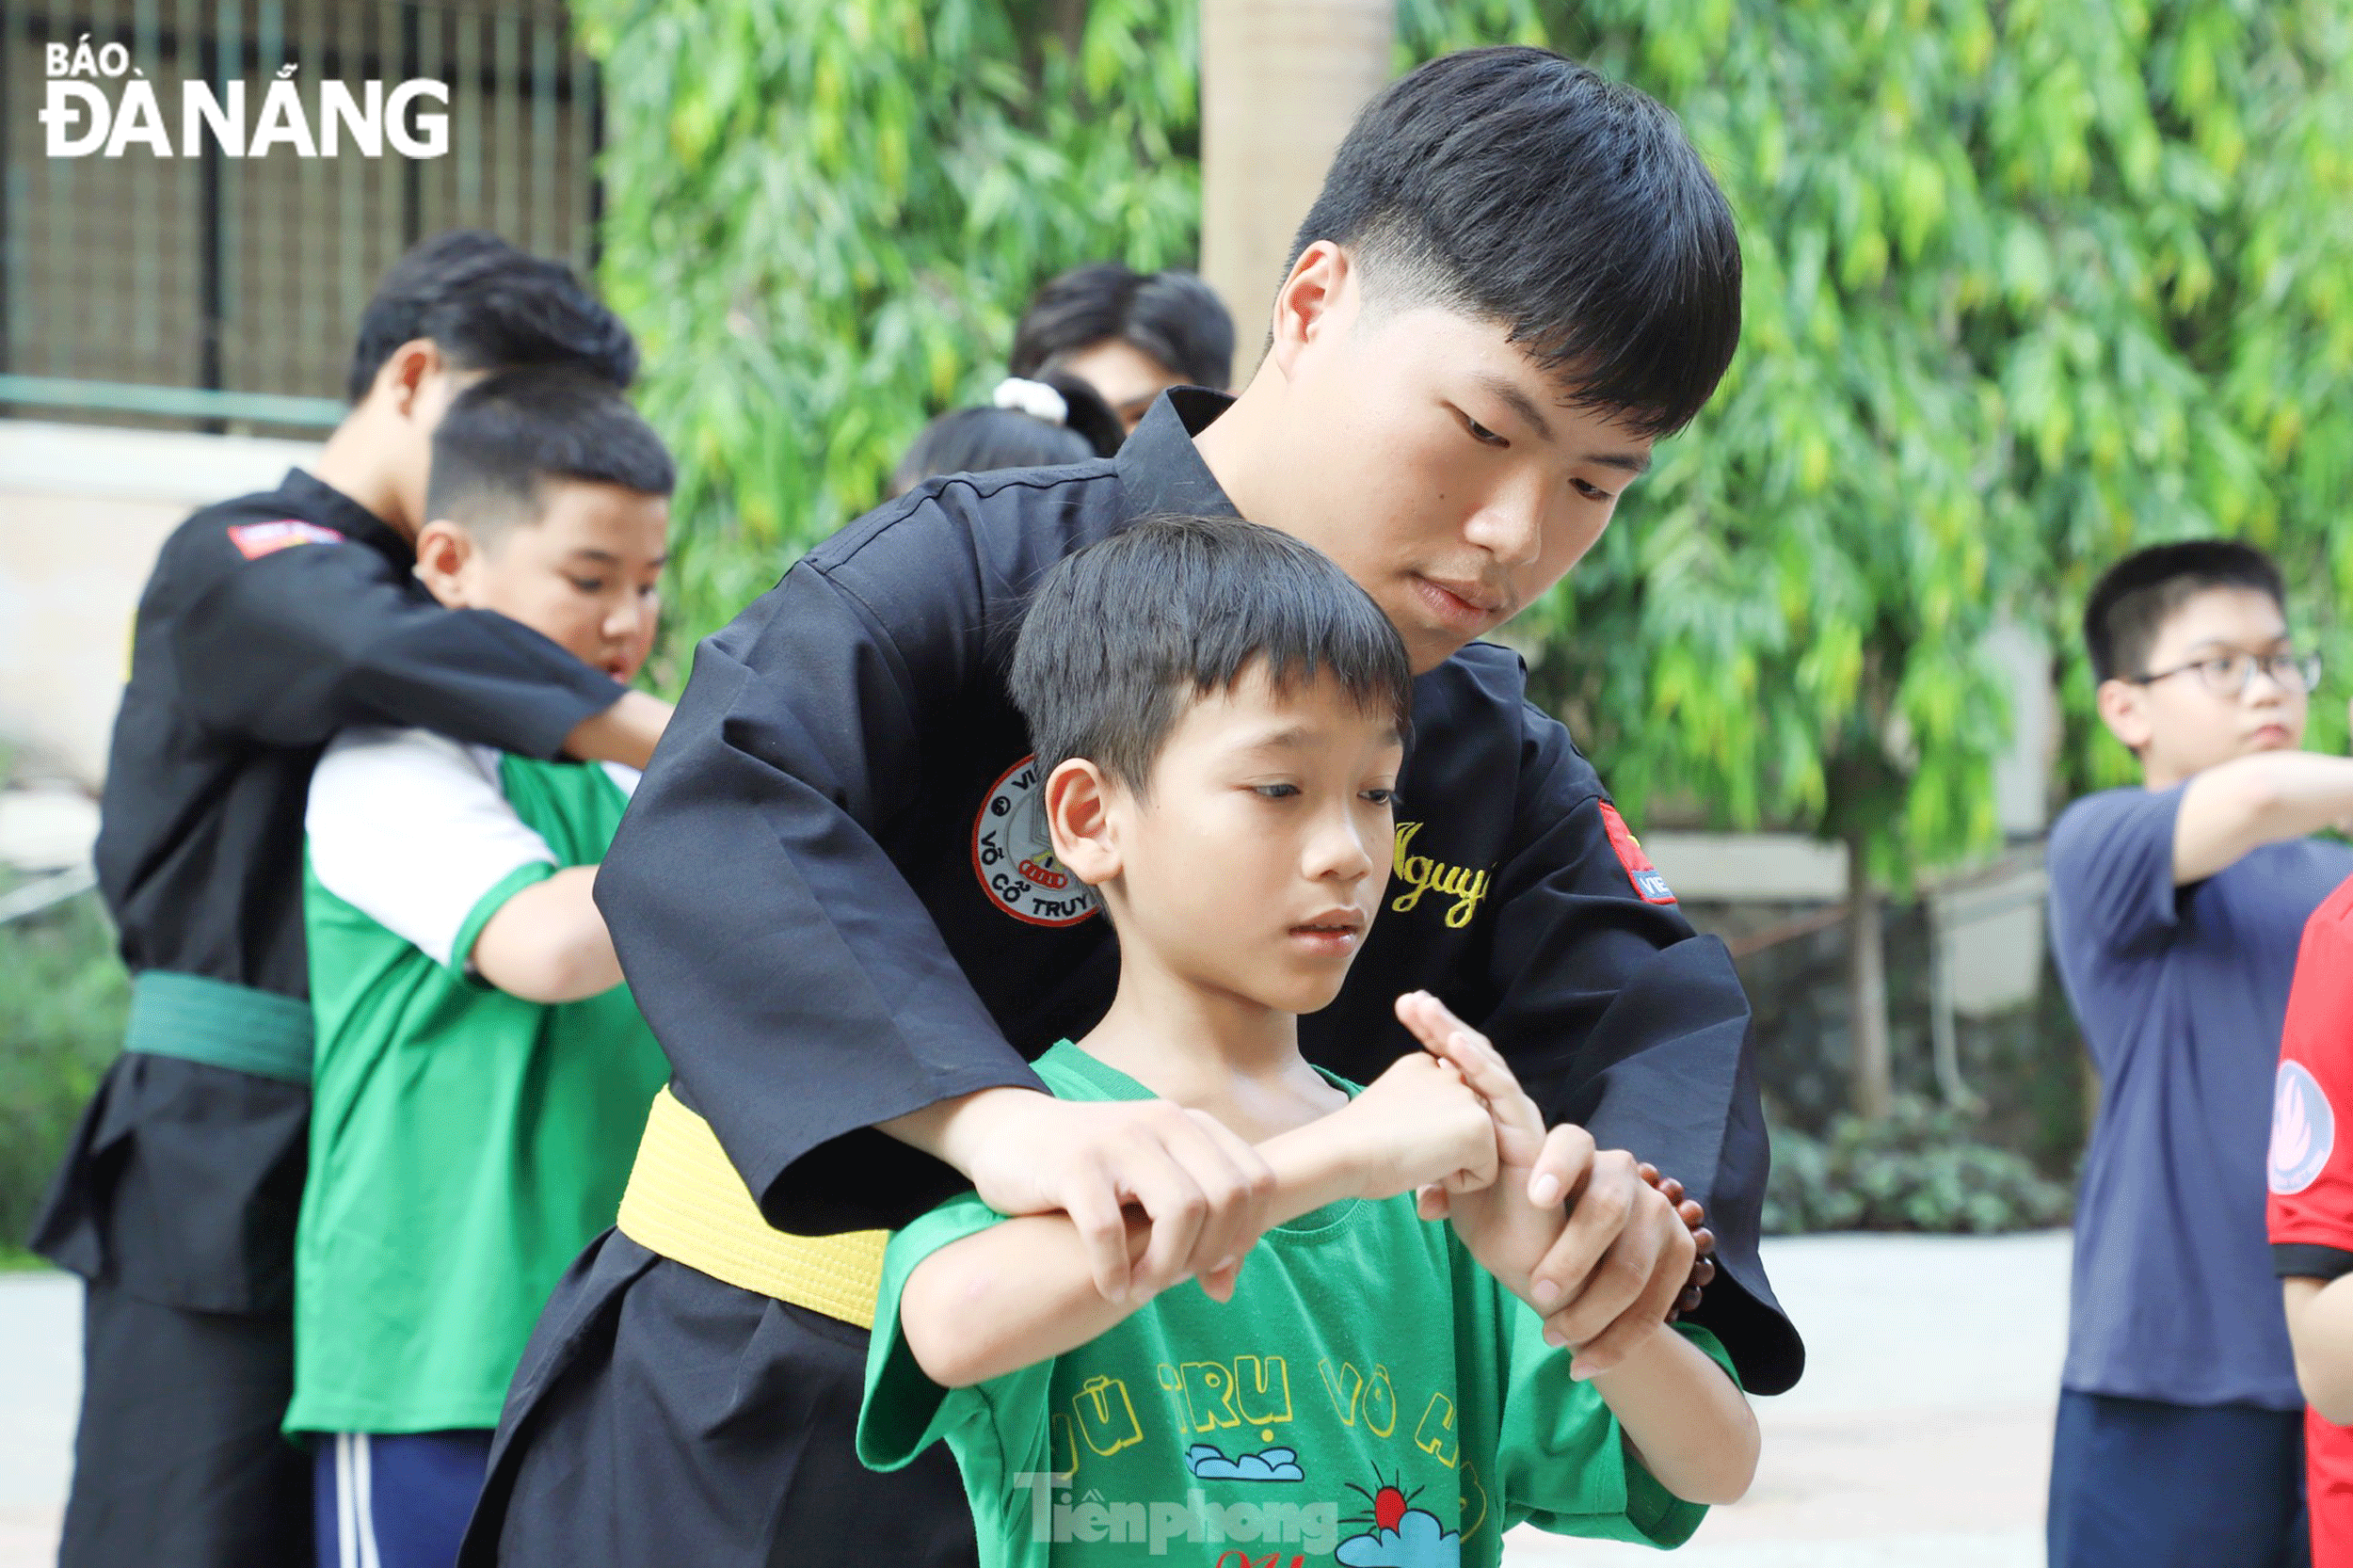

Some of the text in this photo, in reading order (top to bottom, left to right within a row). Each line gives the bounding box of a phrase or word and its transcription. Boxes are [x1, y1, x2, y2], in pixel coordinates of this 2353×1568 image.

[1011, 765, 1037, 791] VI
[980, 830, 1004, 865] VÕ
[992, 873, 1032, 904] CỔ
[1392, 822, 1491, 928] Nguy
